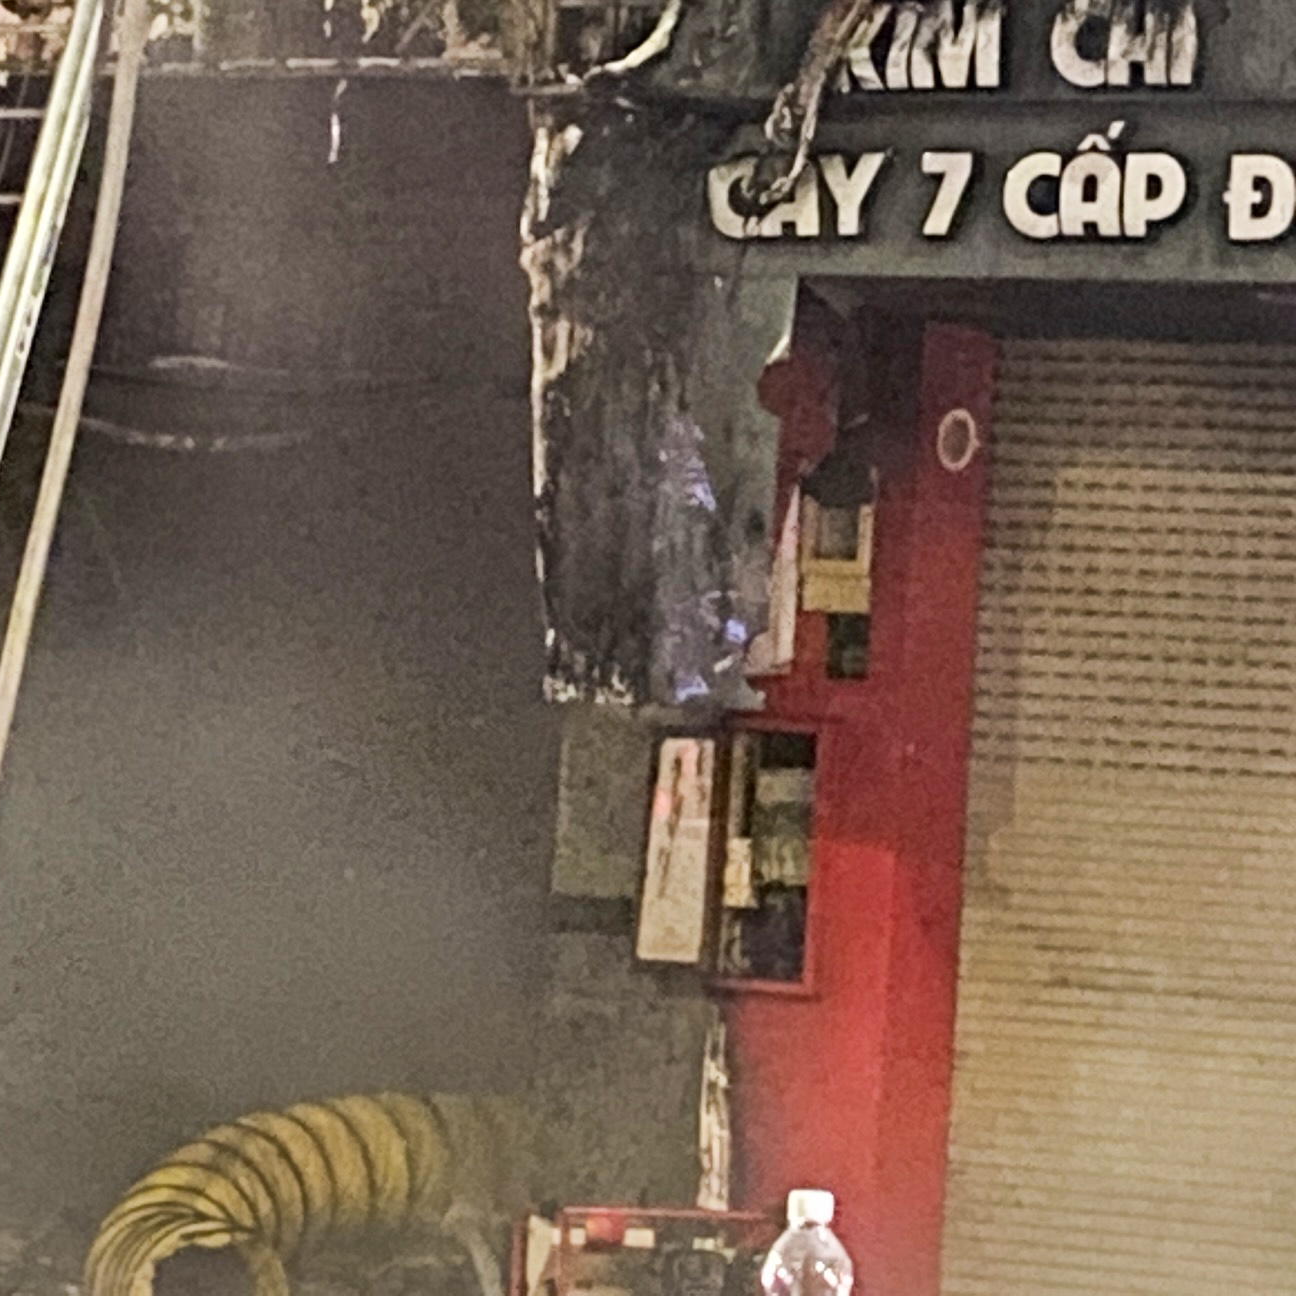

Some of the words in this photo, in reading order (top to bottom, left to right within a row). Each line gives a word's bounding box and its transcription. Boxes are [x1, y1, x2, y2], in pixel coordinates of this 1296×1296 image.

[707, 151, 886, 239] CAY
[921, 151, 973, 238] 7
[1003, 120, 1187, 239] CẤP
